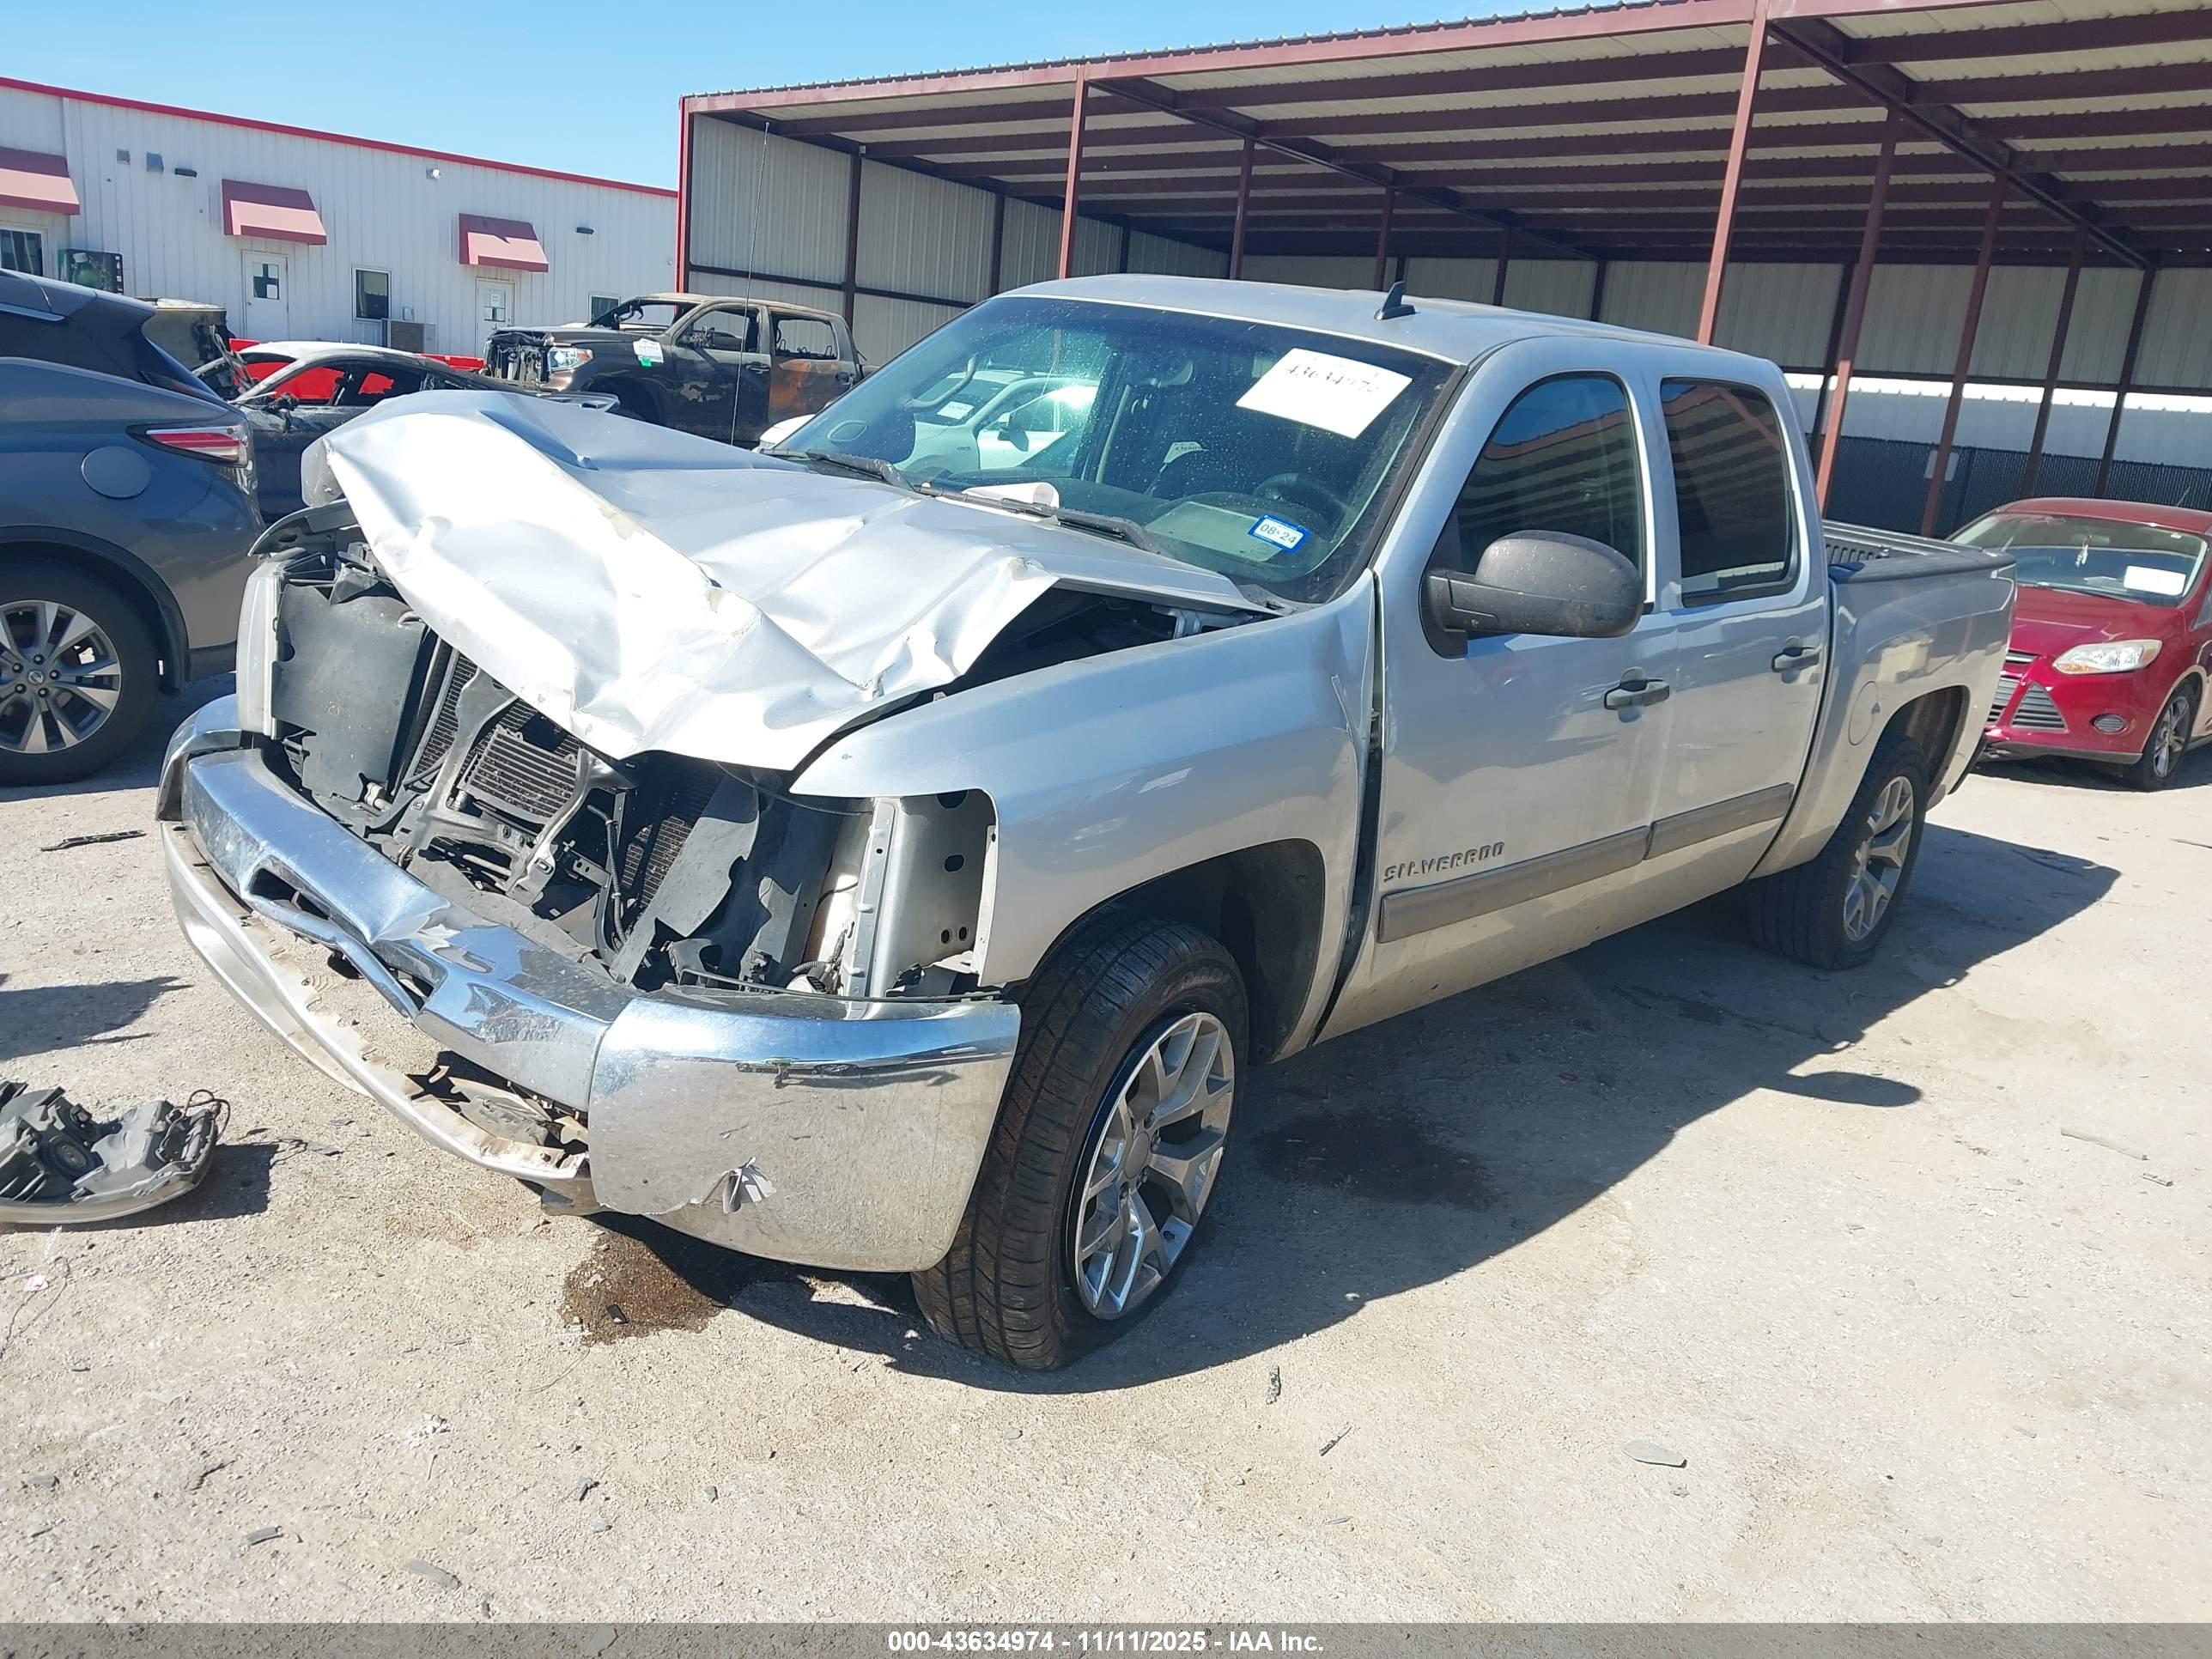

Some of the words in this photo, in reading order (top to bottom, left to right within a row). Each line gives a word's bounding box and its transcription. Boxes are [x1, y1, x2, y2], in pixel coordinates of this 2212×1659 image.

[1260, 524, 1277, 536] 08
[1279, 532, 1297, 544] 24
[1383, 841, 1505, 883] SILVERADO
